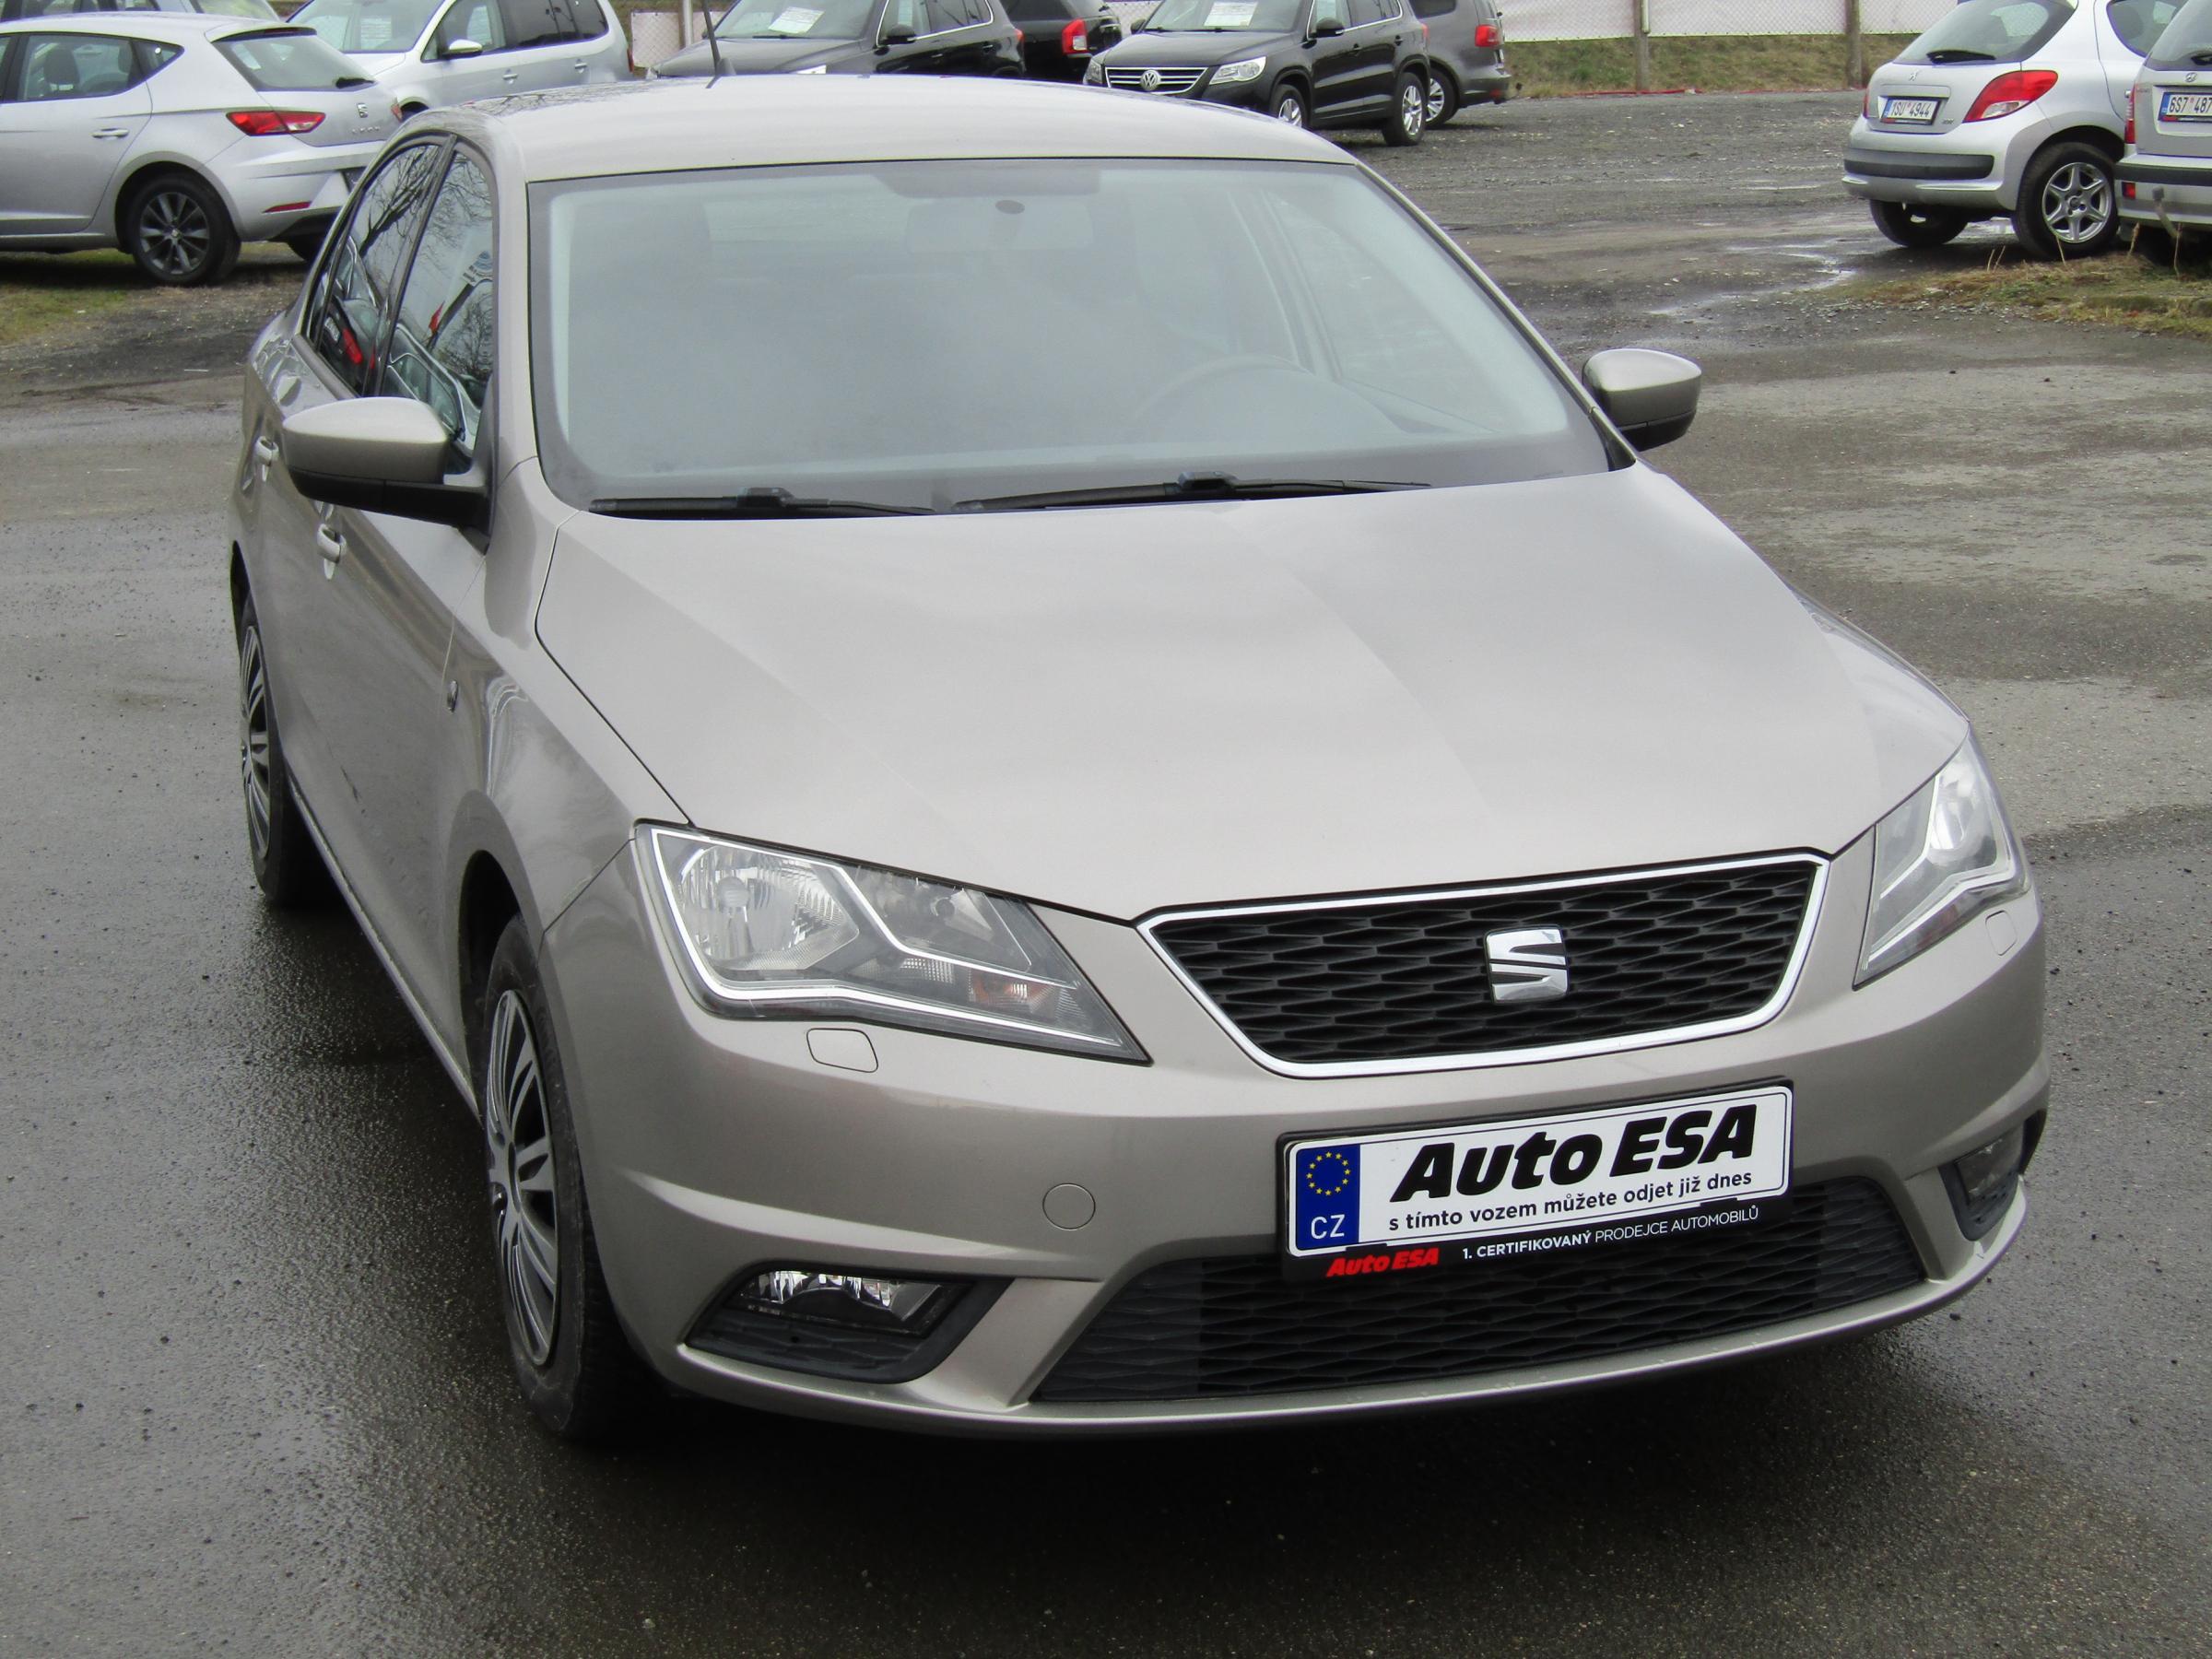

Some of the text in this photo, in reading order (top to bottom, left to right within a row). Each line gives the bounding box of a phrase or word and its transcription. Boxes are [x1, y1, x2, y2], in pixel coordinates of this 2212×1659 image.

[1910, 102, 1932, 117] 4944
[2170, 97, 2189, 112] 6S7
[1389, 1104, 1757, 1202] Auto ESA
[1389, 1172, 1752, 1231] s tímto vozem můžete odjet již dnes
[1311, 1214, 1346, 1240] CZ
[1462, 1205, 1759, 1260] 1. CERTIFIKOVANÝ PRODEJCE AUTOMOBILŮ
[1325, 1247, 1440, 1278] Auto ESA
